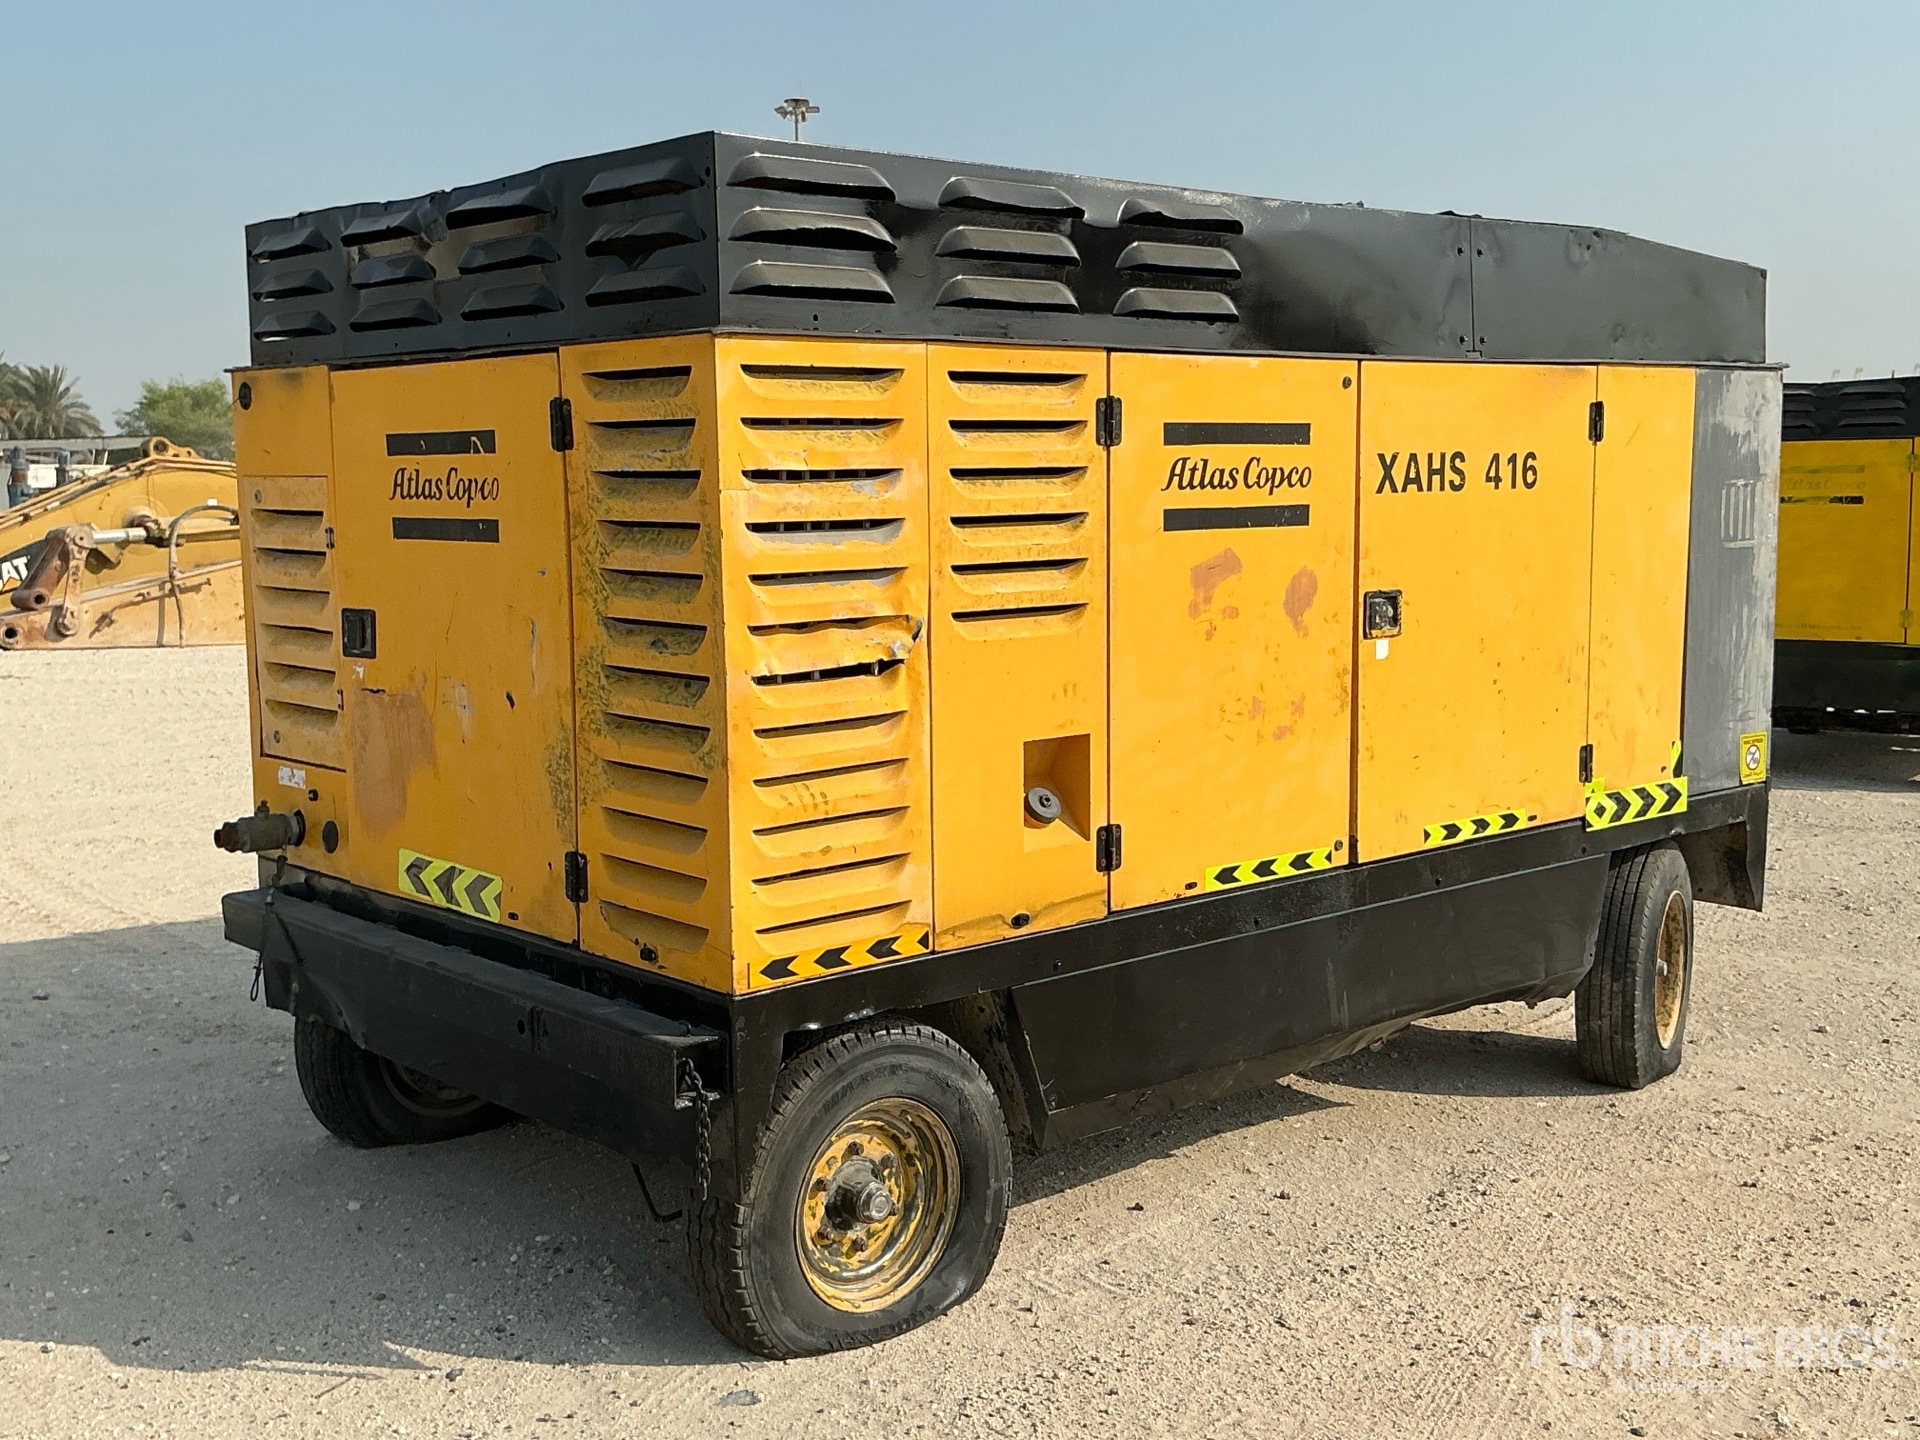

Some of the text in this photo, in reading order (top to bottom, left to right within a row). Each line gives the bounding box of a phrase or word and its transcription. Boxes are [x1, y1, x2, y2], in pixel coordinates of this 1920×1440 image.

[388, 466, 500, 508] Atlas Copco
[1161, 456, 1312, 496] Atlas Copco
[1375, 451, 1538, 494] XAHS 416
[0, 556, 29, 593] AT
